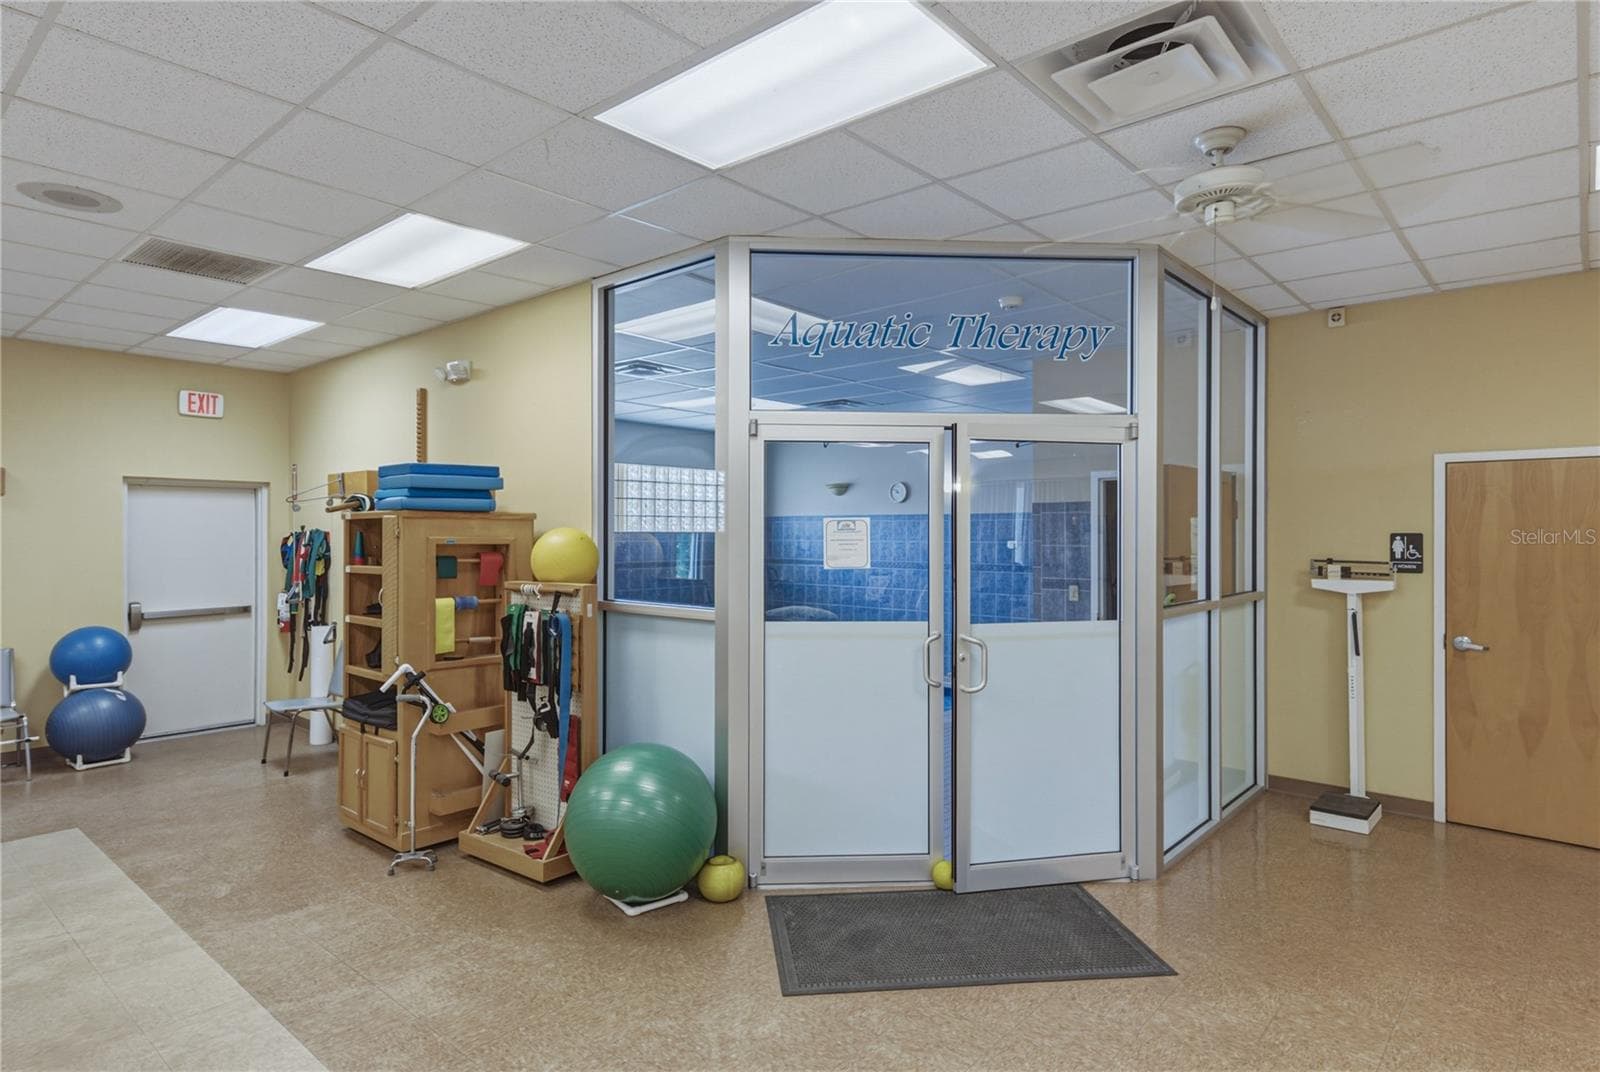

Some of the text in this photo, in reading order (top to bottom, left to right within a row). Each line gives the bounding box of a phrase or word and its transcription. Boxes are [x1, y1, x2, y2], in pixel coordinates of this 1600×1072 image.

[768, 312, 1114, 361] Aquatic Therapy
[188, 392, 218, 415] EXIT
